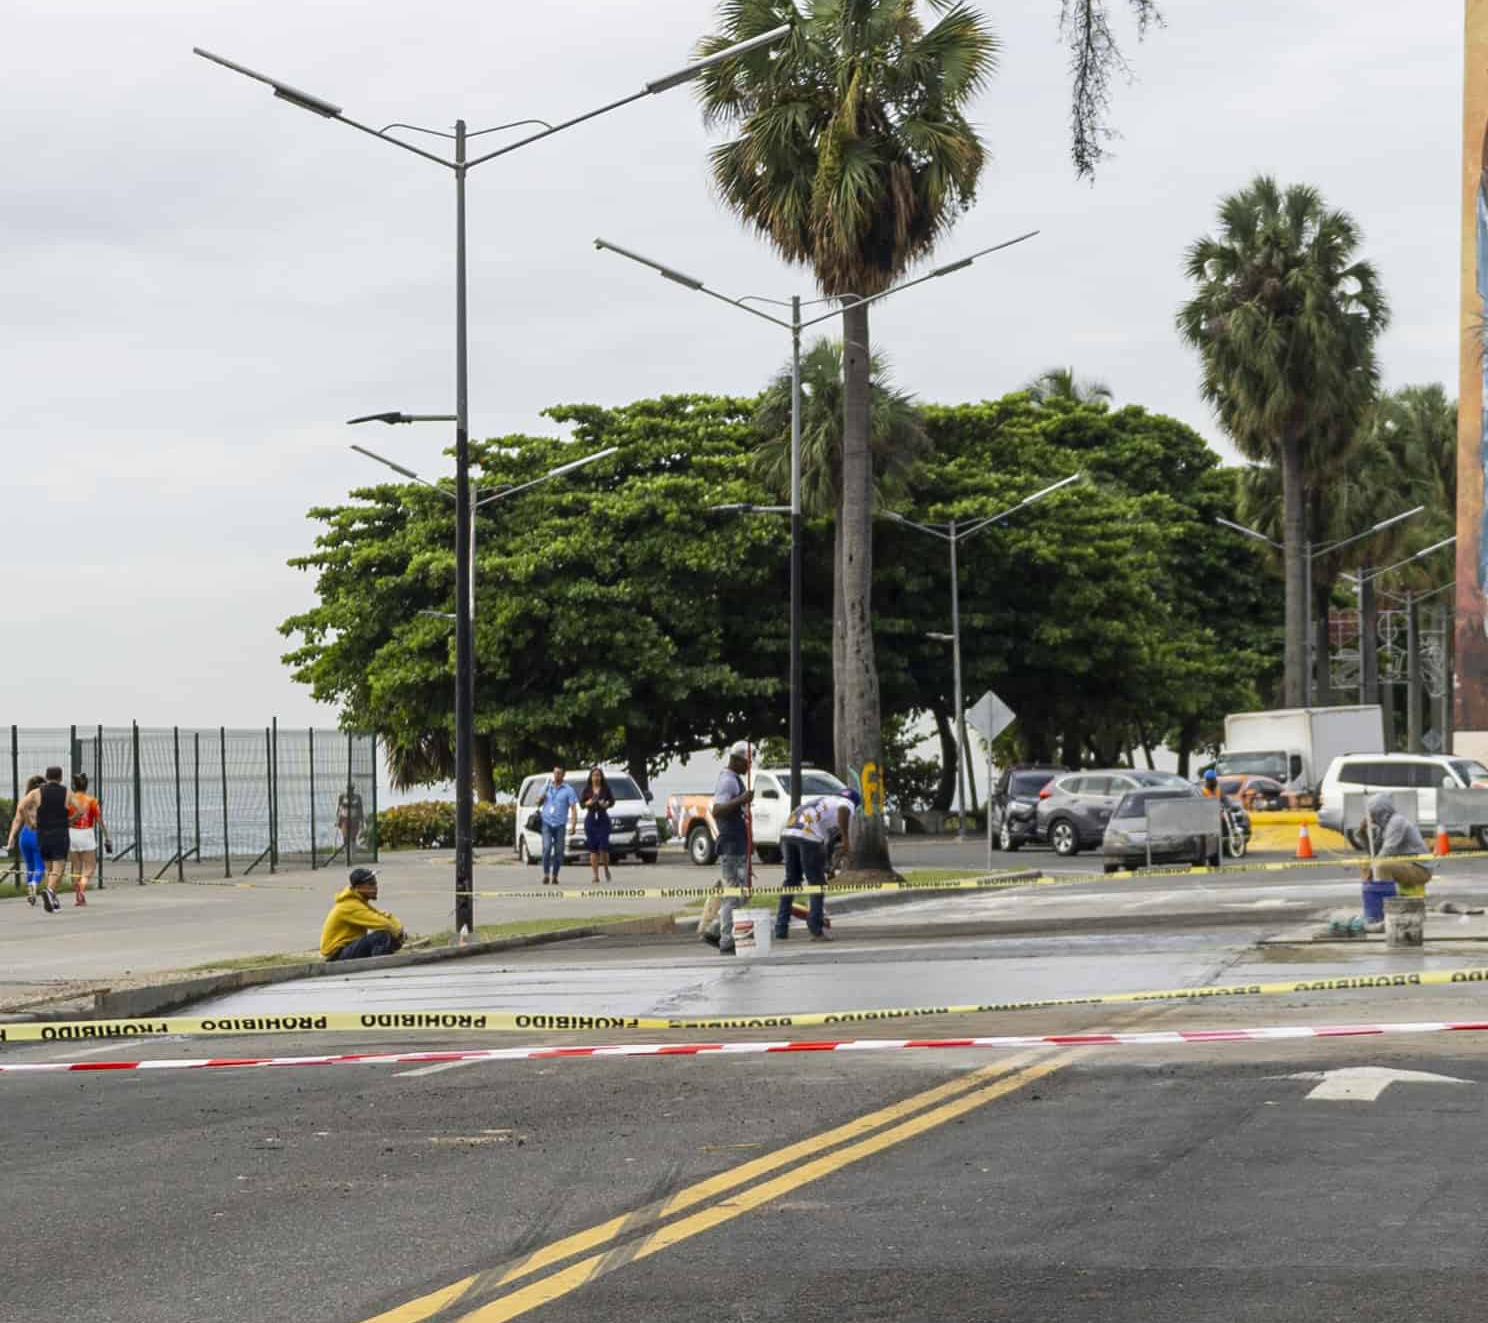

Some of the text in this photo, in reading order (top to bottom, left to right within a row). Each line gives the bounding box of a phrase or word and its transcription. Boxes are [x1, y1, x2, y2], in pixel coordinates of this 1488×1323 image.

[201, 1015, 327, 1030] PROHIBIDO
[361, 1013, 487, 1030] PROHIBIDO
[516, 1015, 639, 1029] PROHIBIDO
[41, 1024, 169, 1042] PROHIBIDO
